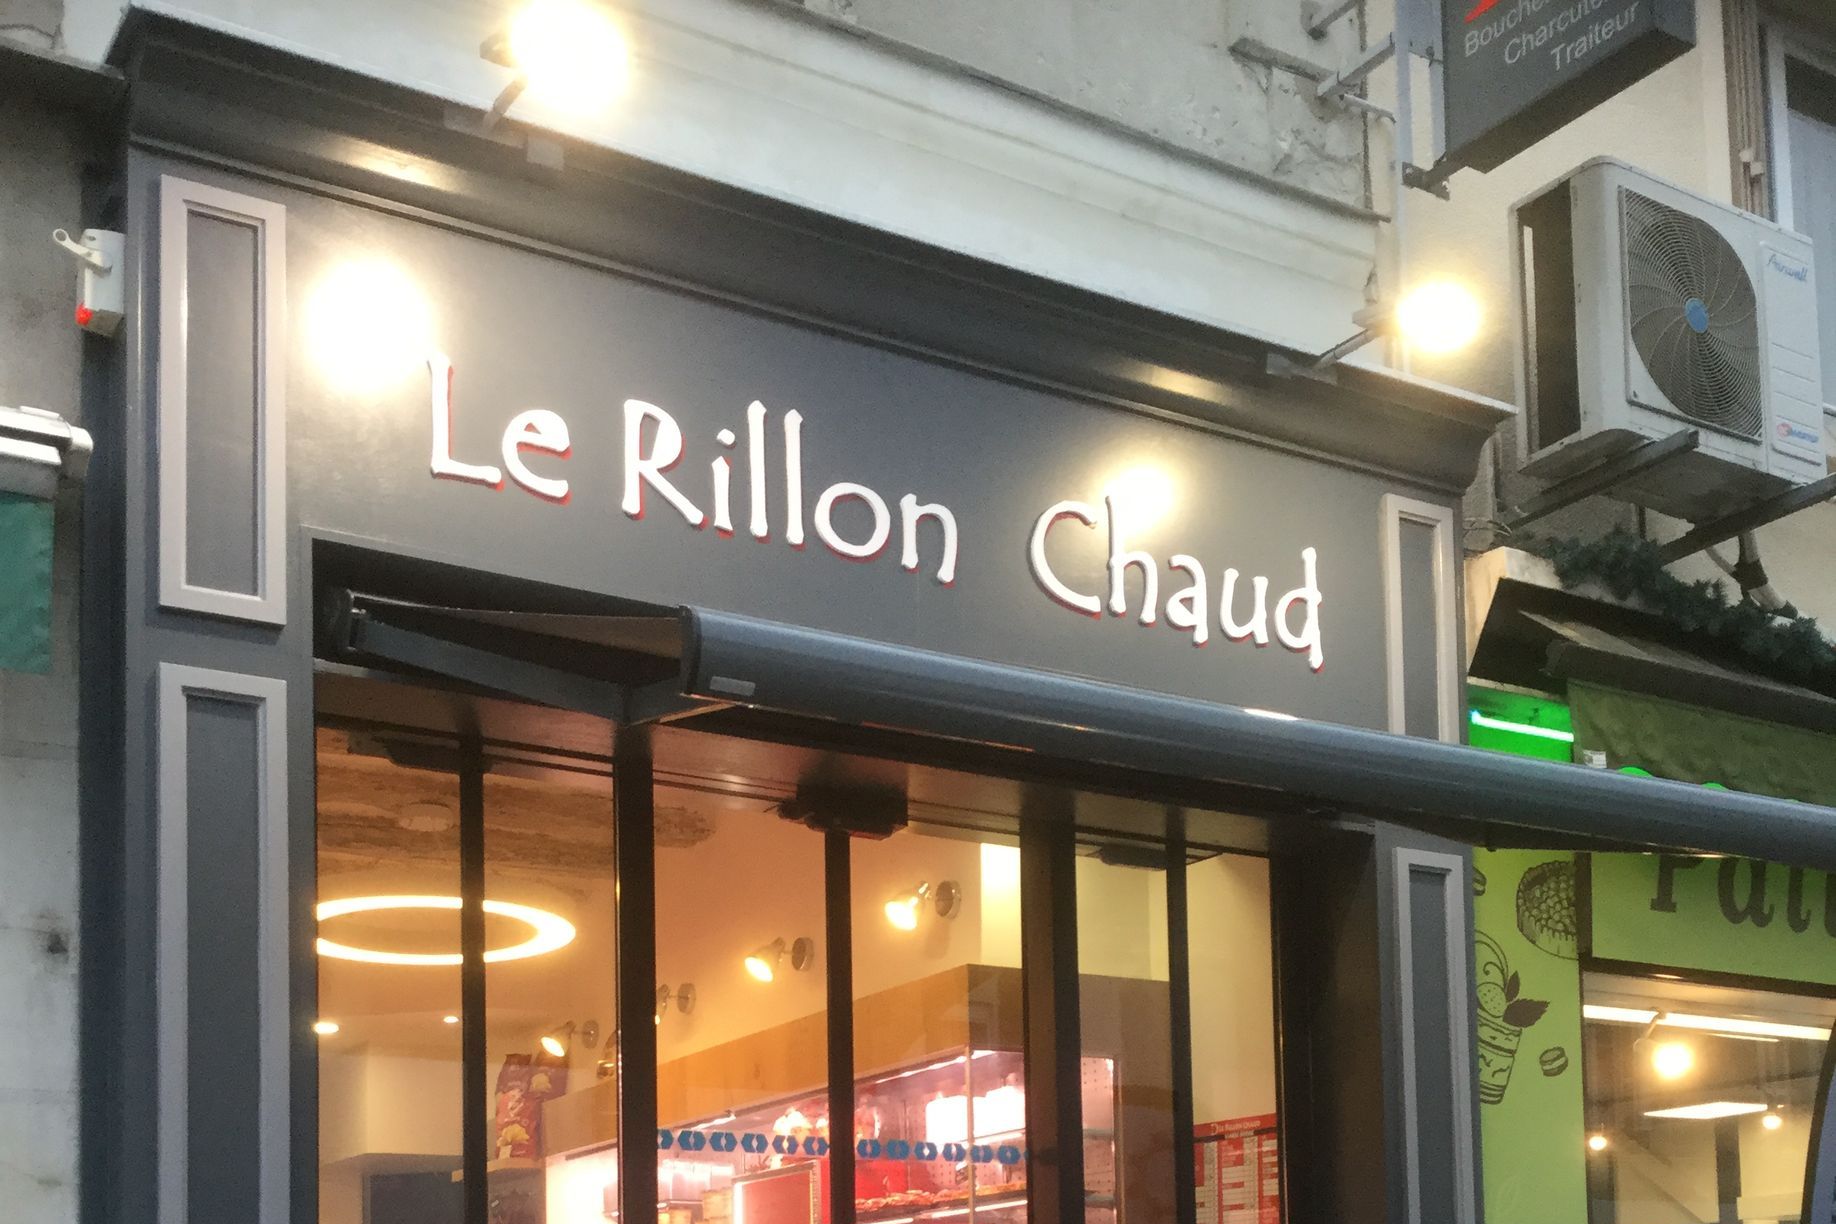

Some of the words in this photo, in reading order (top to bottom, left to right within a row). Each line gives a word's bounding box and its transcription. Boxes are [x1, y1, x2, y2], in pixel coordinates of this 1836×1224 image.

[1465, 0, 1549, 57] Bouche
[1504, 0, 1608, 64] Charcute
[1551, 2, 1639, 71] Traiteur
[425, 353, 572, 502] Le
[620, 399, 961, 588] Rillon
[1029, 490, 1326, 675] Chaud
